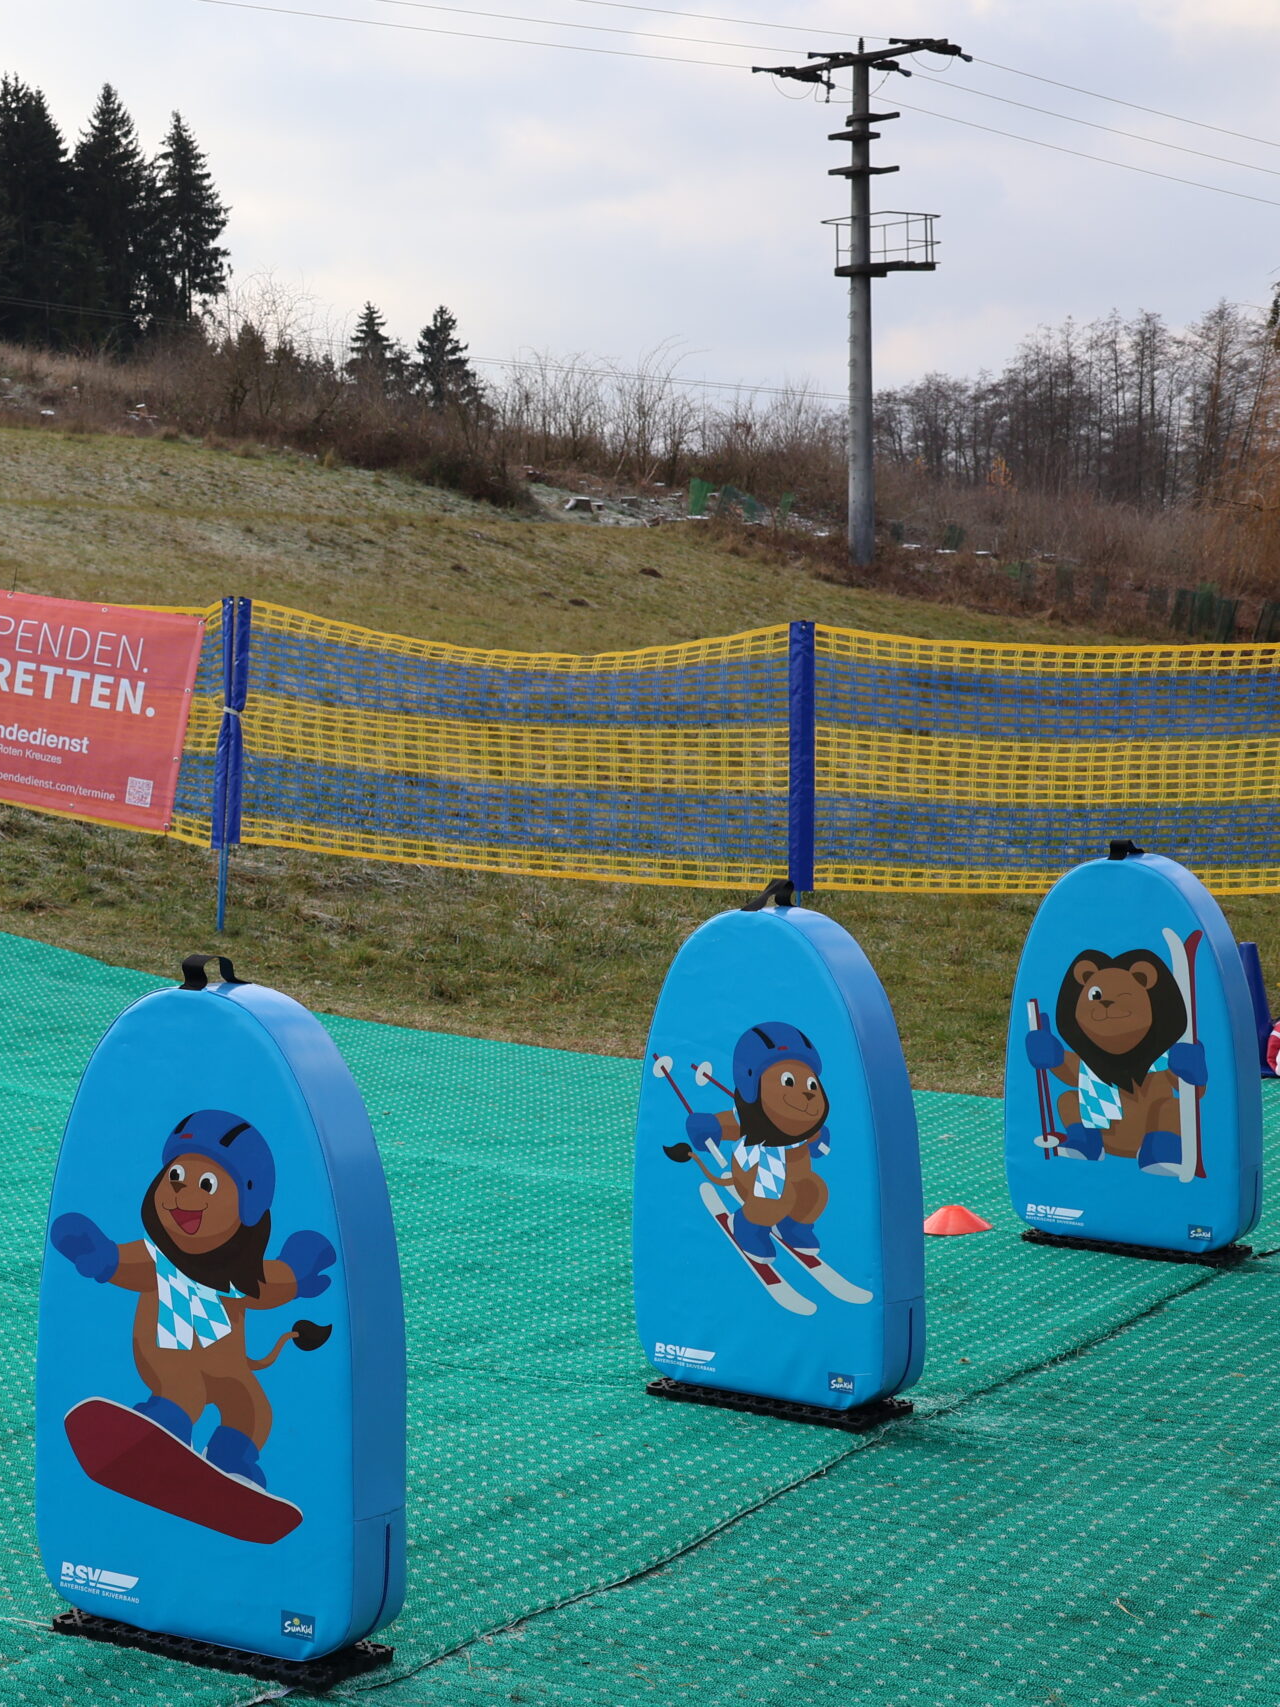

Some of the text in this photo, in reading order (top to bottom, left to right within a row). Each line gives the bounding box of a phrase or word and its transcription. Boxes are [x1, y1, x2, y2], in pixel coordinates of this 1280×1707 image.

[25, 749, 62, 765] Kreuzes
[1026, 1203, 1056, 1218] BSV
[654, 1342, 686, 1360] BSV
[60, 1561, 102, 1587] BSV
[60, 1581, 140, 1604] BAYERISCHER SKIVERBAND
